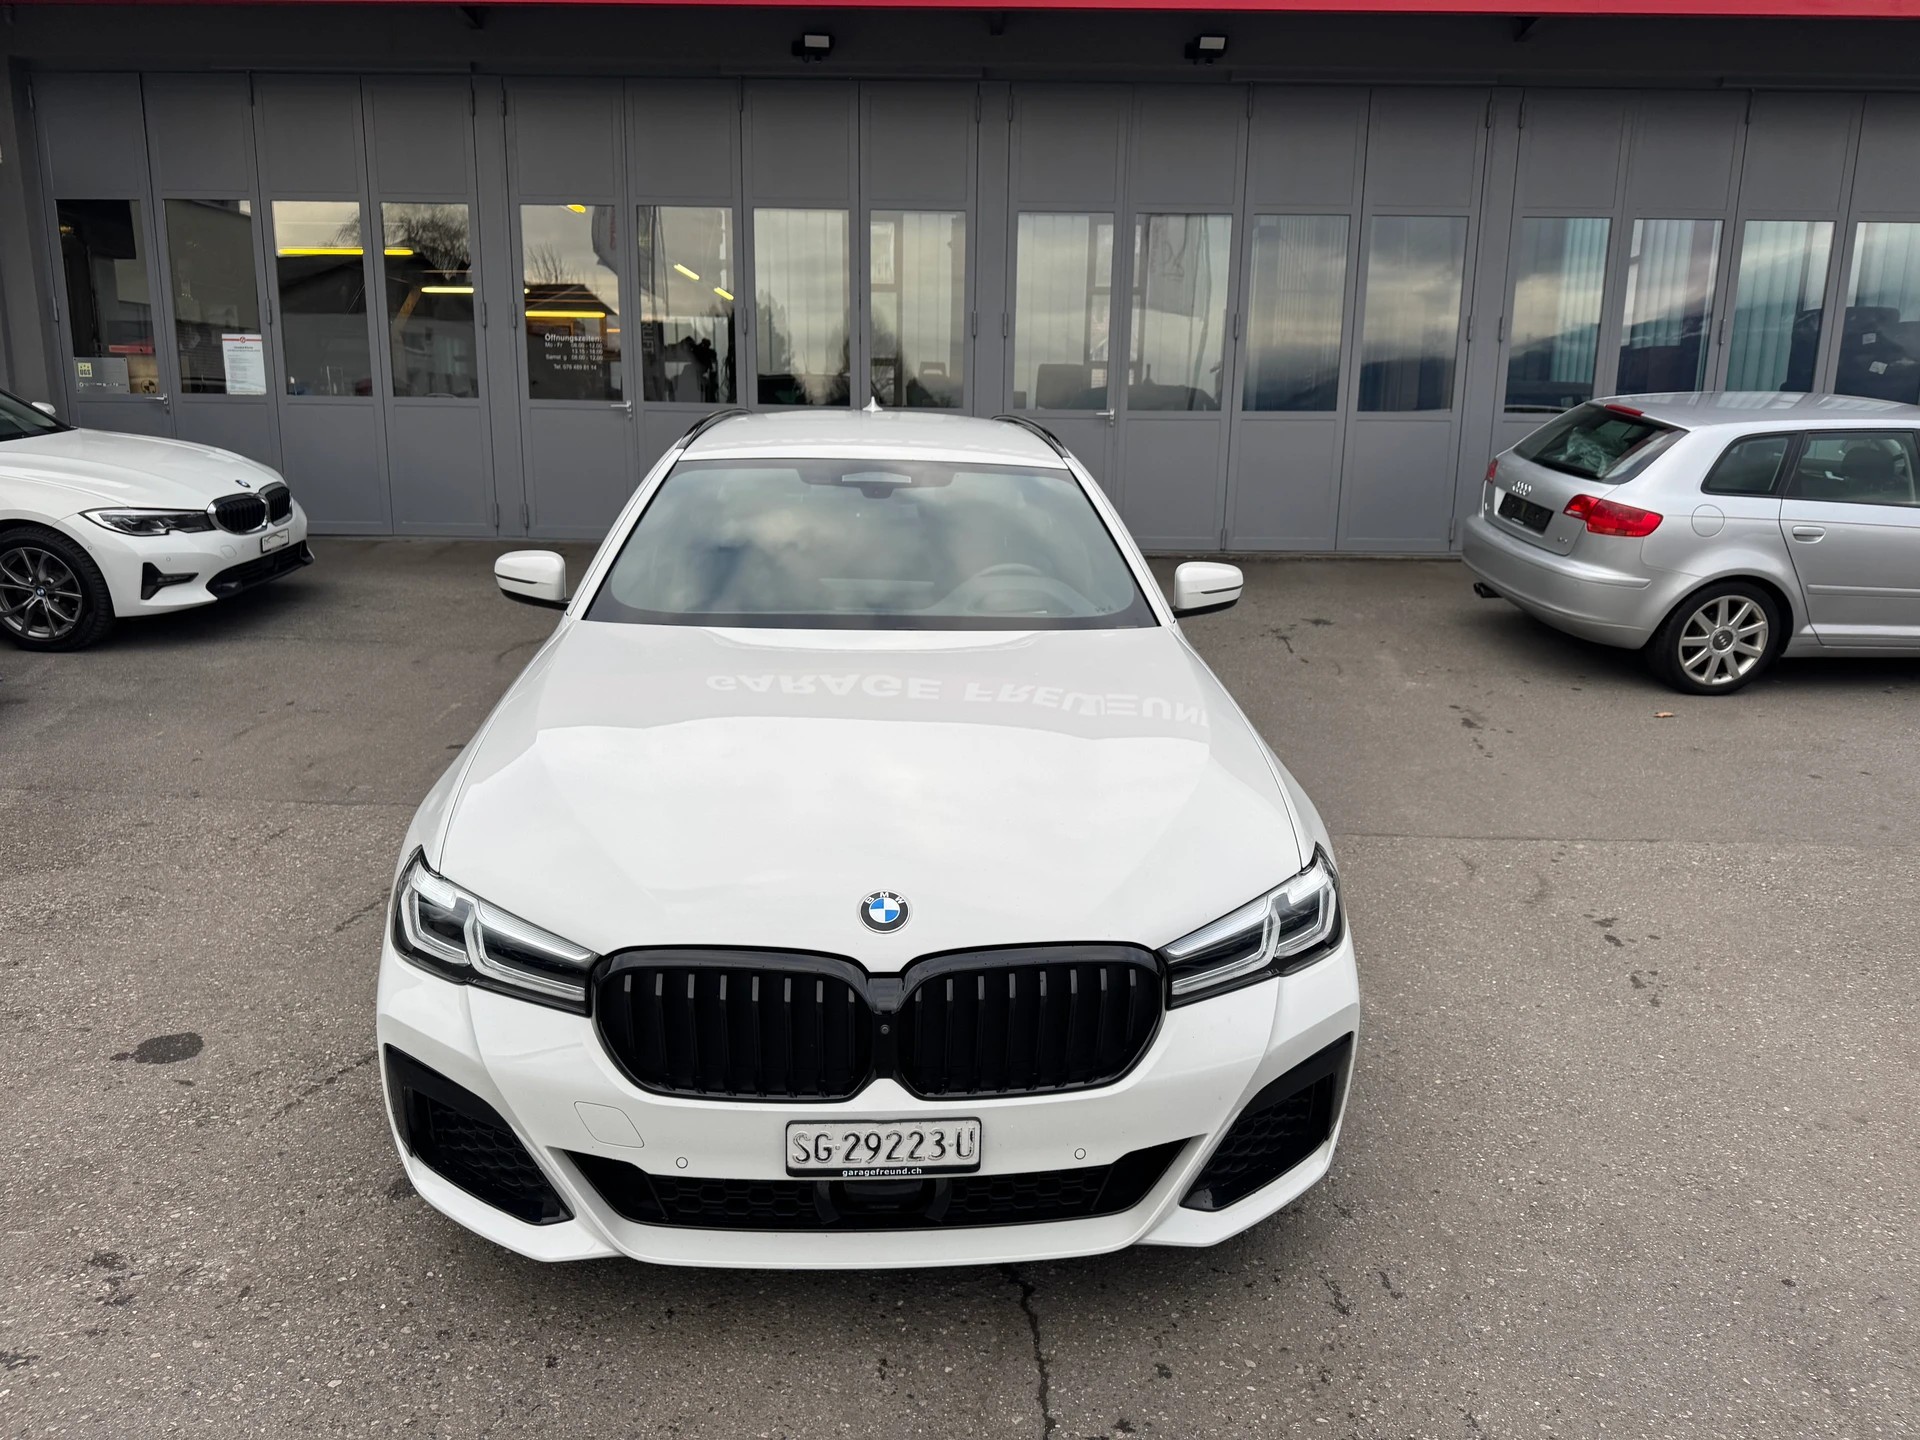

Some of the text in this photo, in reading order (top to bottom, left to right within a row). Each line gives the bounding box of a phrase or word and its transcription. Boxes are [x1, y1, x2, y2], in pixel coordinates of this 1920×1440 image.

[545, 333, 602, 343] Öffnungszeiten:
[864, 890, 906, 905] BMW
[842, 1167, 922, 1176] garagefreund.ch
